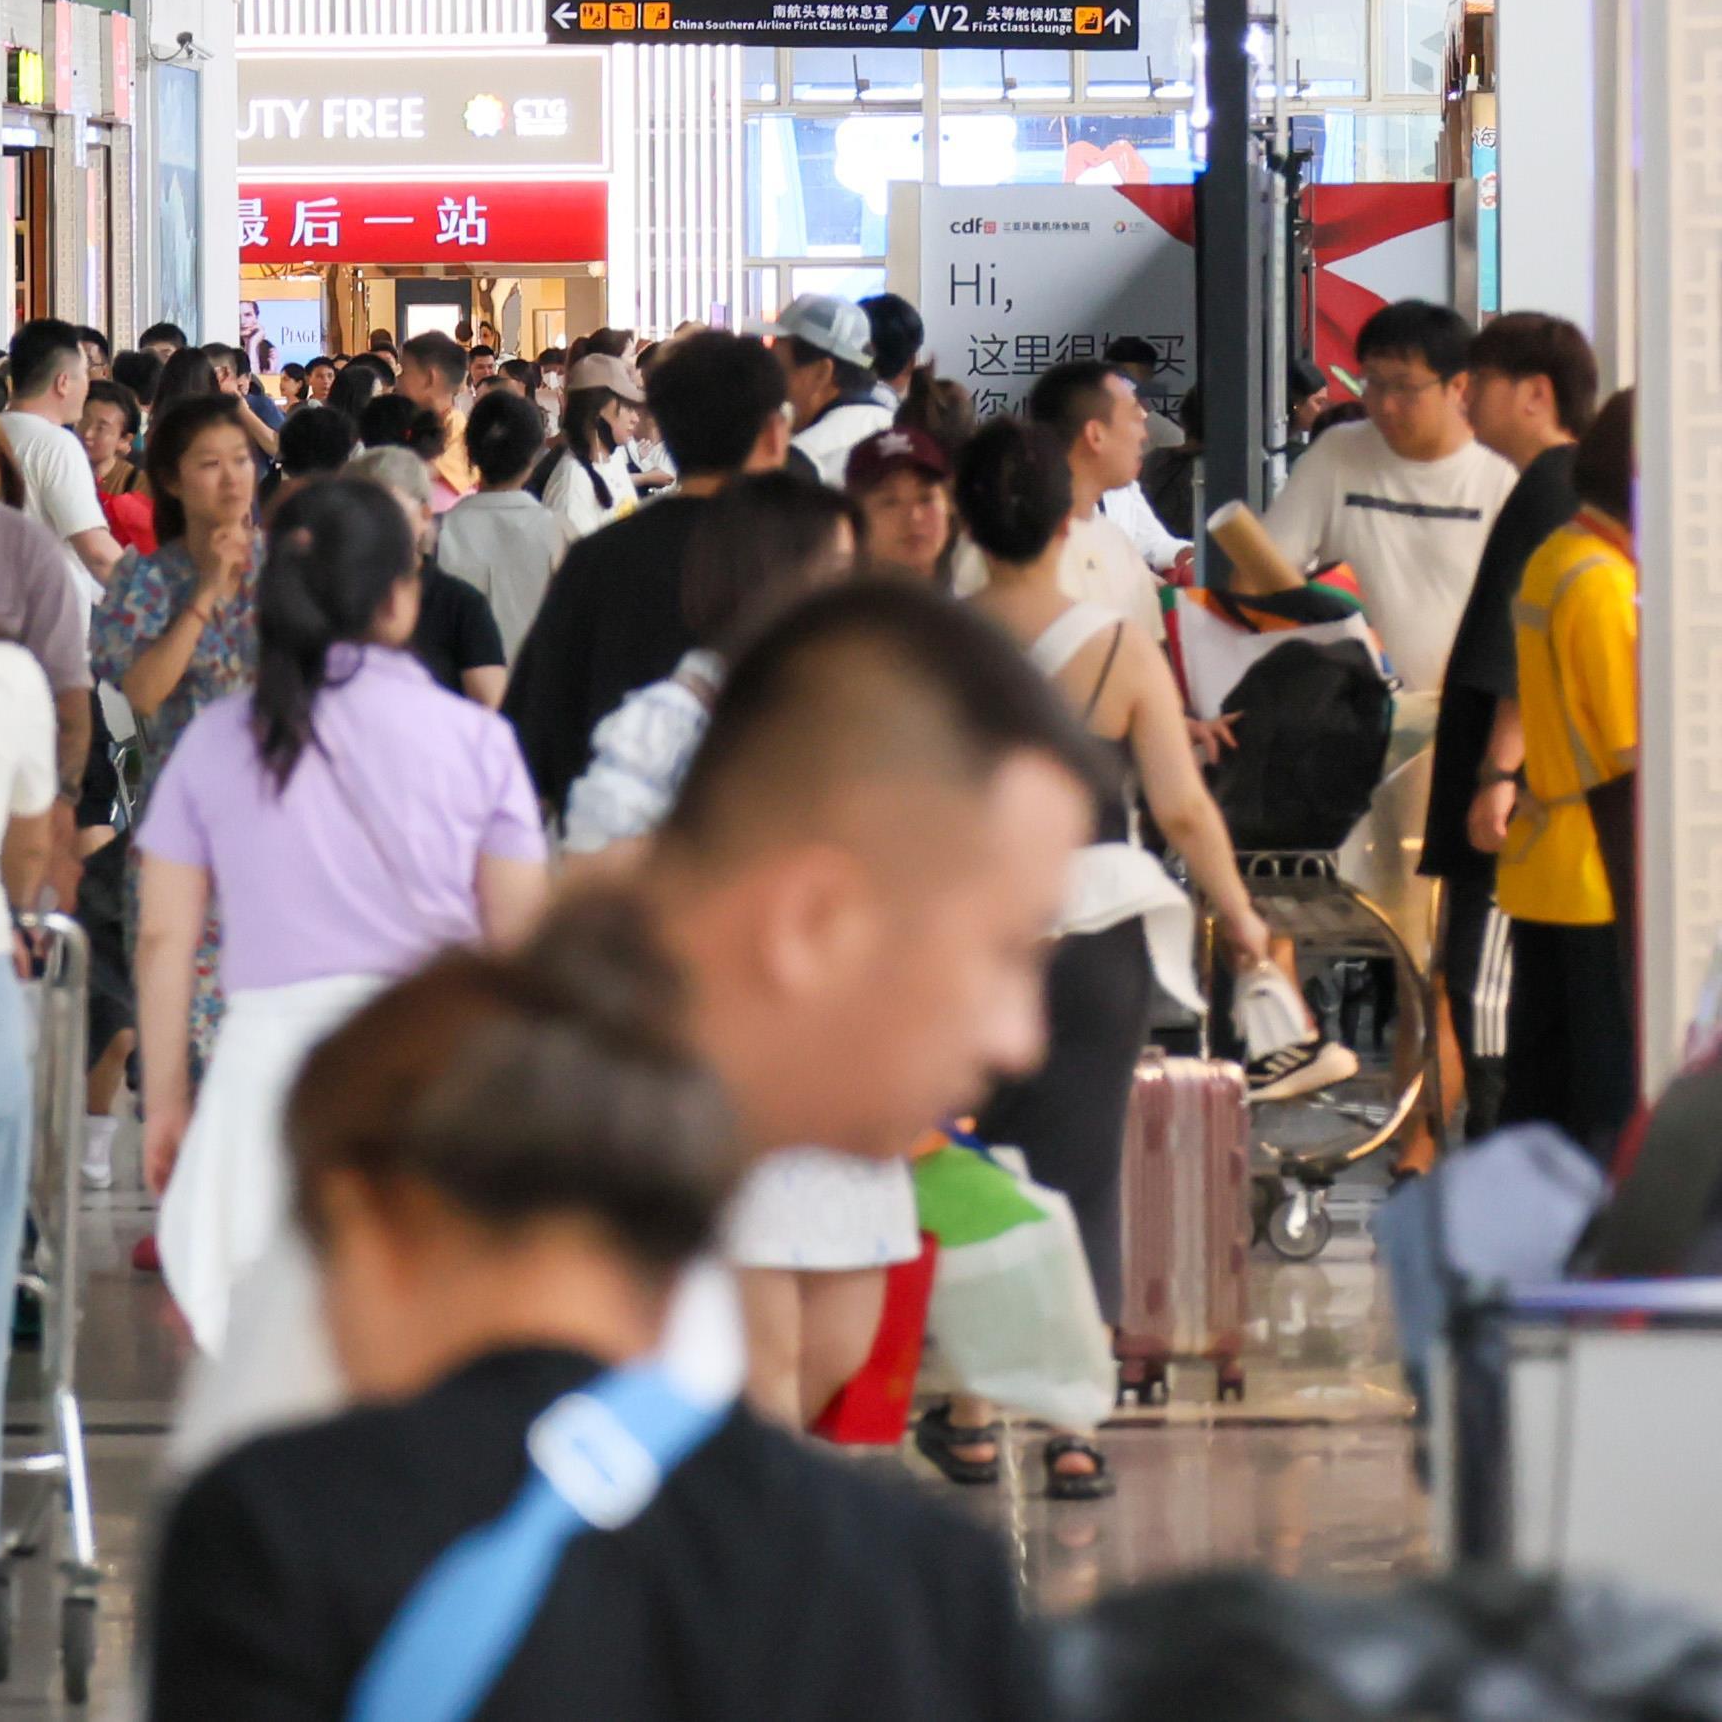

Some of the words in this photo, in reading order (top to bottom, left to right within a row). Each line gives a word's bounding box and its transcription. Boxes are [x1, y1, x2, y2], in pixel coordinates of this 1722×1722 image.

[772, 3, 889, 20] 南航头等舱休息室
[929, 4, 970, 32] V2
[986, 5, 1073, 23] 头等舱候机室
[672, 19, 704, 30] China
[705, 20, 755, 31] Southern
[755, 19, 793, 31] Airline
[793, 20, 819, 31] First
[819, 20, 848, 31] Class
[848, 21, 888, 34] Lounge
[972, 21, 999, 33] First
[999, 22, 1030, 33] Class
[1030, 20, 1073, 36] Lounge
[321, 96, 425, 139] FREE
[513, 98, 568, 118] CTG
[237, 195, 489, 248] 最后一站
[950, 217, 986, 234] cdf
[950, 263, 1013, 314] Hi,
[967, 333, 1187, 376] 这里很买
